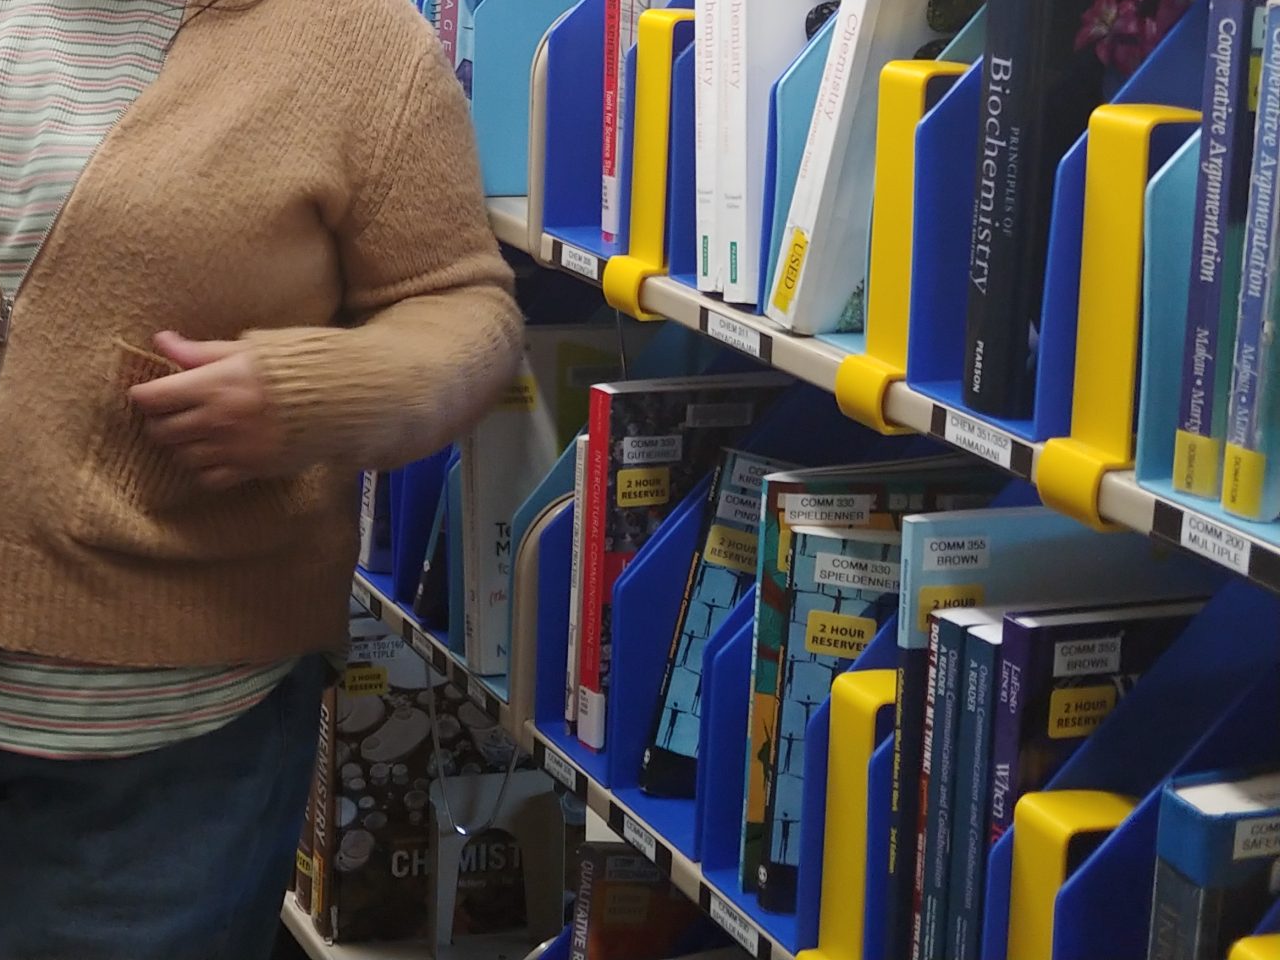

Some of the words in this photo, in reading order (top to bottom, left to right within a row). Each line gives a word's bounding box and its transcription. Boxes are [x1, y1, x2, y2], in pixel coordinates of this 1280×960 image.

[822, 14, 858, 121] Chemistry
[1210, 18, 1237, 135] Cooperative
[605, 89, 614, 111] Tools
[971, 54, 1012, 295] Biochemistry
[1005, 127, 1020, 205] PRINCIPLES
[1003, 213, 1014, 238] OF
[1199, 145, 1227, 283] Argumentation
[1247, 151, 1274, 298] Argumentation
[783, 241, 805, 291] USED
[711, 328, 757, 355] THIYAGARAJAH
[1192, 327, 1213, 382] Makan
[972, 340, 985, 394] PEARSON
[1236, 343, 1256, 396] Makan
[630, 440, 659, 448] COMM
[950, 415, 975, 434] CHEM
[976, 425, 1009, 450] 351/352
[955, 433, 1000, 462] HAMADANI
[590, 449, 602, 539] INTERCULTURAL
[621, 490, 666, 500] RESERVES
[626, 480, 633, 489] 2
[634, 479, 661, 488] HOUR
[725, 495, 757, 508] COMM
[800, 498, 835, 507] COMM
[836, 497, 855, 507] 330
[789, 511, 865, 520] SPIELDENNER
[719, 537, 726, 546] 2
[727, 540, 757, 554] HOUR
[929, 541, 966, 552] COMM
[966, 540, 986, 550] 355
[1188, 516, 1222, 540] COMM
[1225, 535, 1244, 552] 200
[1188, 532, 1241, 566] MULTIPLE
[832, 558, 869, 570] COMM
[870, 564, 891, 575] 330
[936, 554, 978, 565] BROWN
[586, 541, 599, 646] COMMUNICATION
[819, 569, 900, 591] SPIELDENNER
[933, 599, 940, 609] 2
[943, 598, 976, 608] HOUR
[811, 636, 868, 652] RESERVES
[819, 623, 827, 633] 2
[830, 625, 865, 638] HOUR
[928, 622, 939, 662] DON'T
[358, 649, 395, 659] MULTIPLE
[1060, 644, 1096, 657] COMM
[1066, 658, 1108, 671] BROWN
[926, 665, 937, 701] MAKE
[936, 654, 947, 696] READER
[946, 649, 959, 689] Online
[976, 664, 989, 705] Online
[1000, 659, 1012, 703] Larson
[967, 669, 977, 712] READER
[1009, 664, 1021, 714] LaFasto
[1064, 703, 1071, 713] 2
[1074, 700, 1108, 712] HOUR
[924, 703, 935, 727] ME
[921, 728, 934, 775] THINK!
[940, 691, 957, 783] Communication
[969, 707, 986, 800] Communication
[318, 704, 330, 848] CHEMISTRY
[992, 762, 1010, 819] When
[938, 785, 950, 806] and
[968, 804, 980, 825] and
[934, 809, 949, 888] Collaboration
[964, 827, 978, 909] Collaboration
[572, 860, 595, 951] QUALITATIVE
